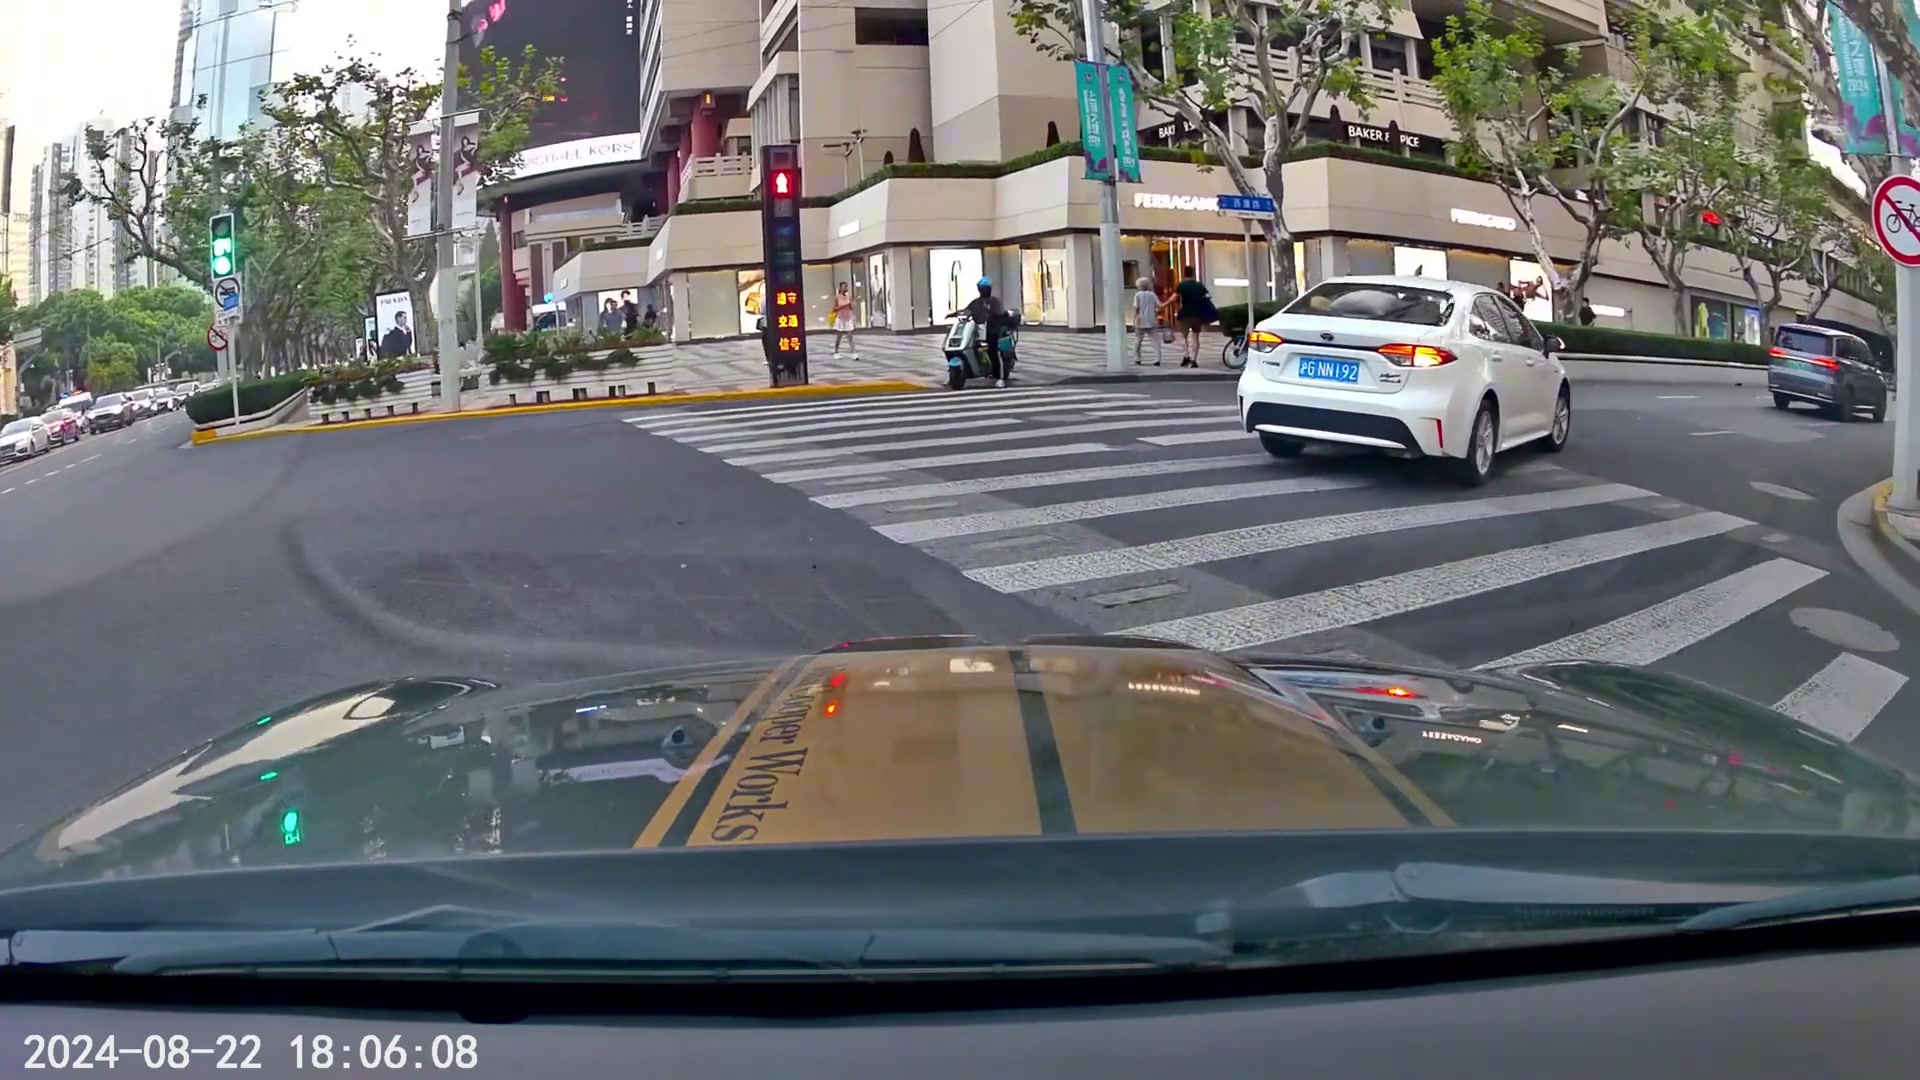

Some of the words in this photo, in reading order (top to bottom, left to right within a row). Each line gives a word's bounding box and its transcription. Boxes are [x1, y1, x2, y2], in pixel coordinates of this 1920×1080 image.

[1347, 125, 1383, 141] BAKER
[1400, 134, 1420, 148] PICE
[1134, 193, 1219, 211] FERRAGAM
[778, 314, 799, 328] 交通
[779, 336, 801, 351] 信号
[711, 747, 809, 842] Works
